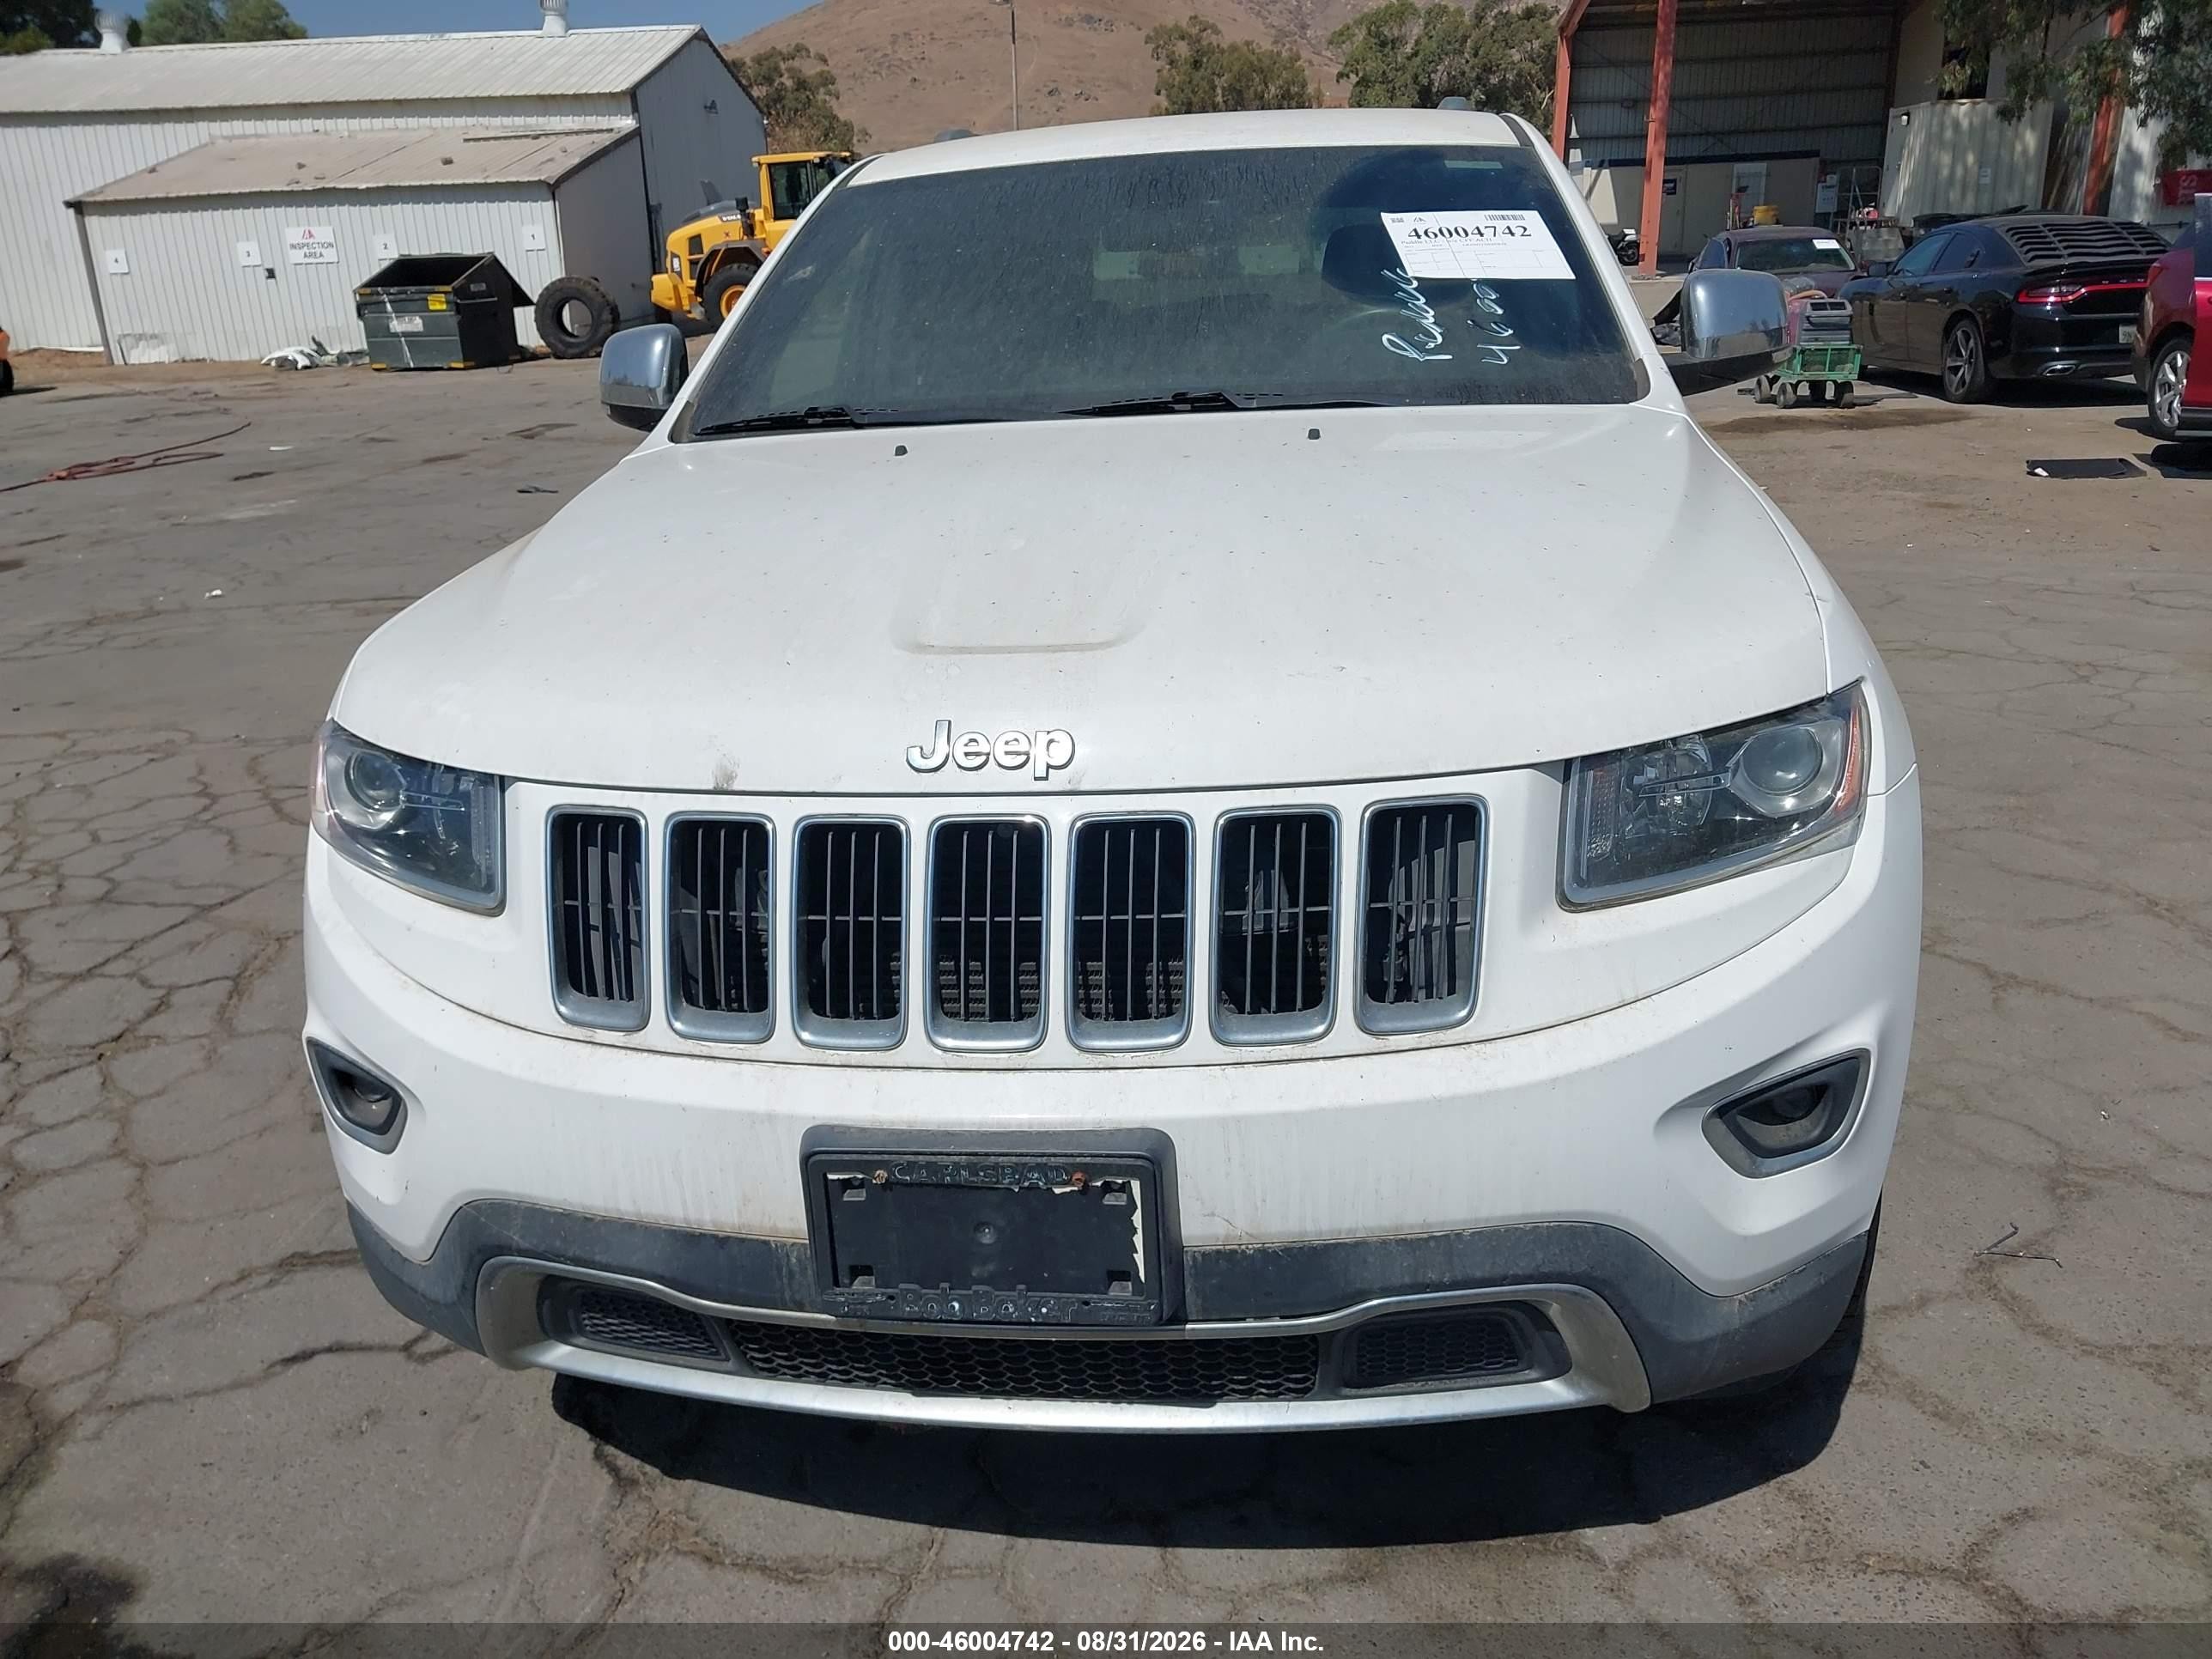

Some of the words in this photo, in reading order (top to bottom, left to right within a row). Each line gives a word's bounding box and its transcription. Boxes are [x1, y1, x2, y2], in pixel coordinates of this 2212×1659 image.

[1407, 225, 1532, 240] 46004742
[289, 240, 335, 251] INSPECTION
[303, 251, 325, 259] AREA
[1467, 279, 1522, 365] 4600
[905, 719, 1076, 781] Jeep
